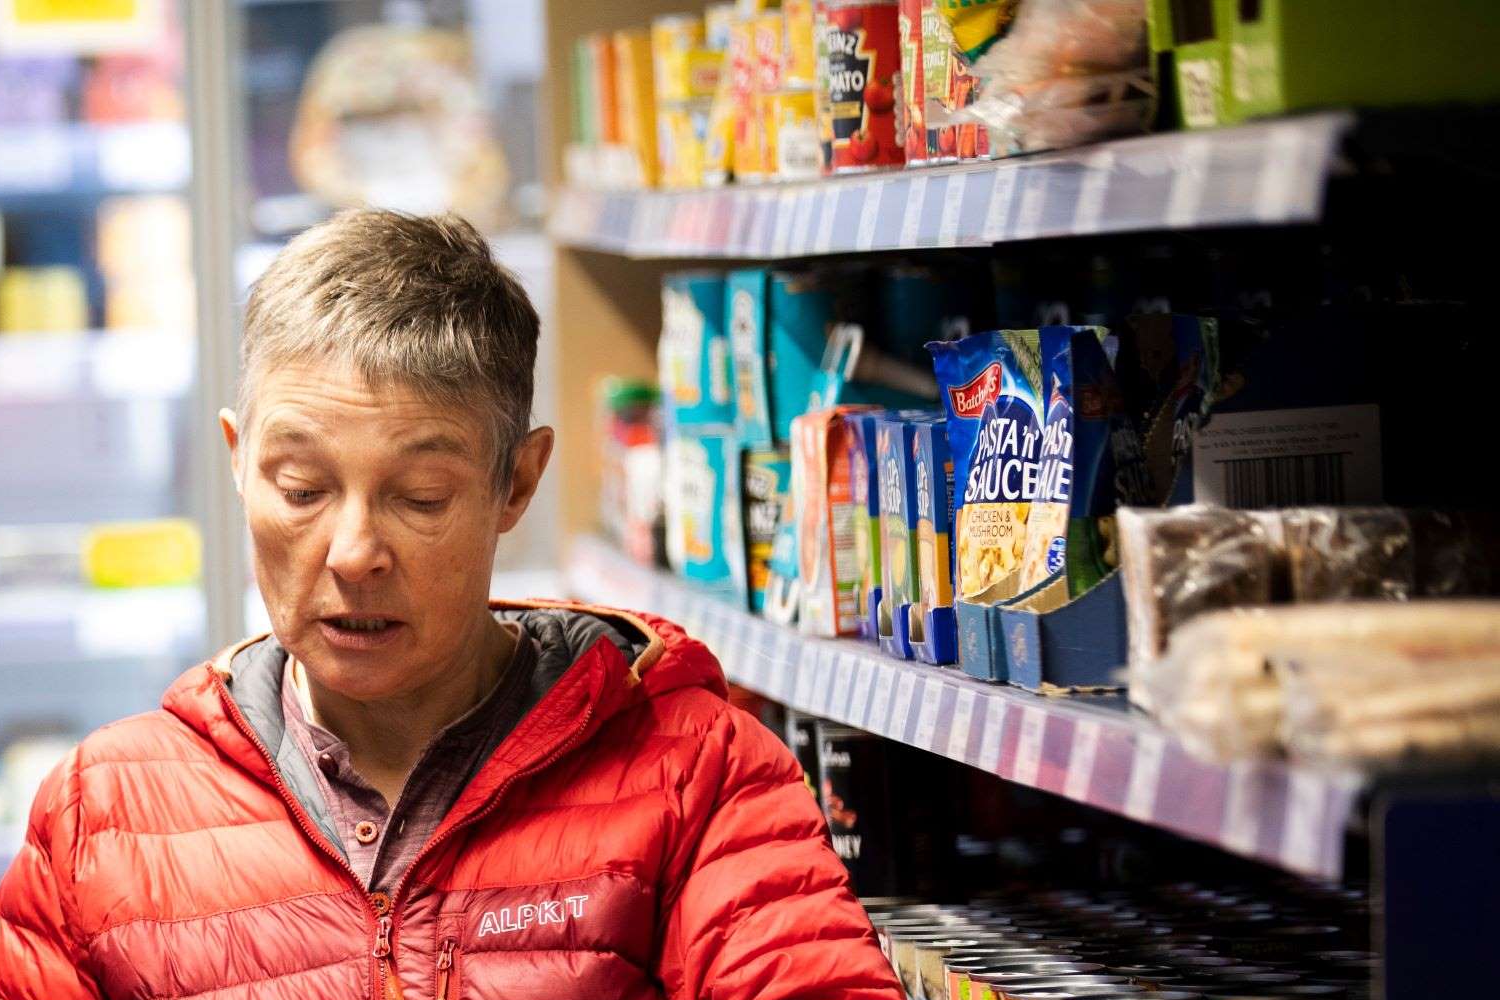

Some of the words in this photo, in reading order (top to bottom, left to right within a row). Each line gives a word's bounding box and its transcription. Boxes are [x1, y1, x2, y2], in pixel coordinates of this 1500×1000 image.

[975, 418, 1018, 463] PASTA
[965, 459, 1040, 501] SAUCE
[971, 511, 1003, 523] CHICKEN
[1004, 511, 1011, 523] &
[969, 526, 1013, 537] MUSHROOM
